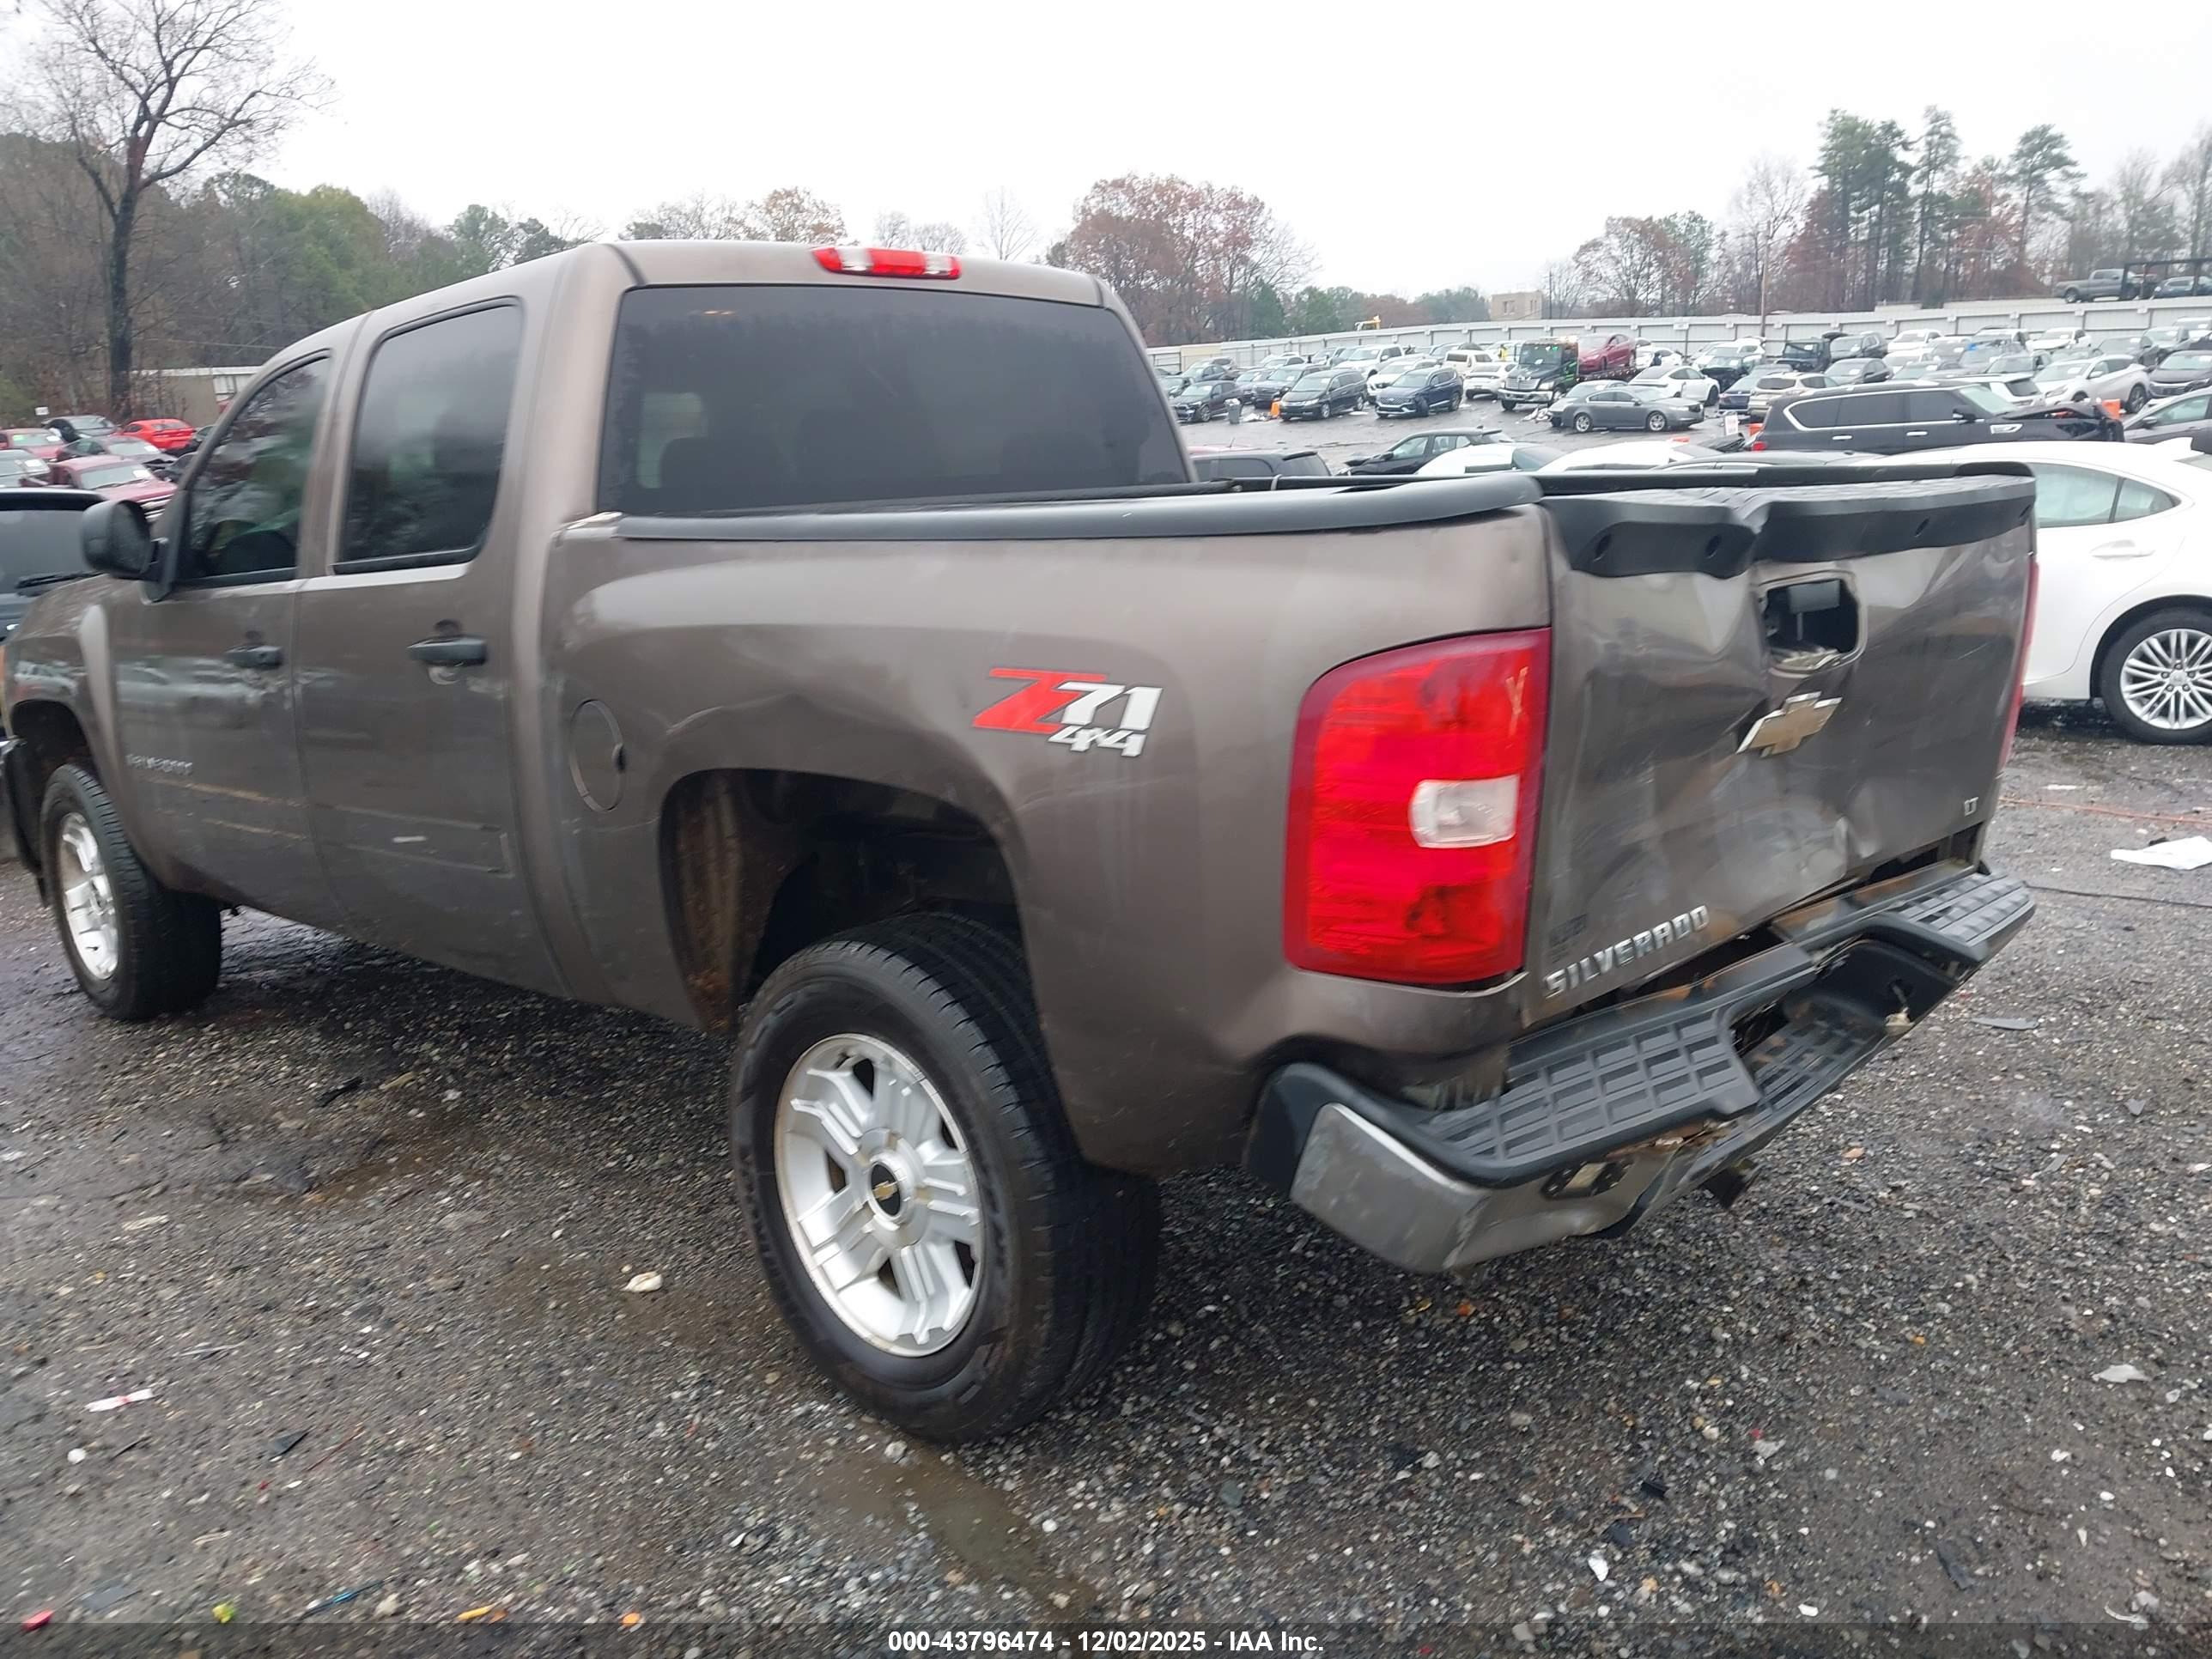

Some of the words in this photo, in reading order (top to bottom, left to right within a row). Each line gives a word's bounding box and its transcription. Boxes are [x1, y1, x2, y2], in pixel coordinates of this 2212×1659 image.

[972, 667, 1163, 734] Z71
[1964, 796, 1979, 817] LT
[1543, 904, 1711, 1000] SILVERADO
